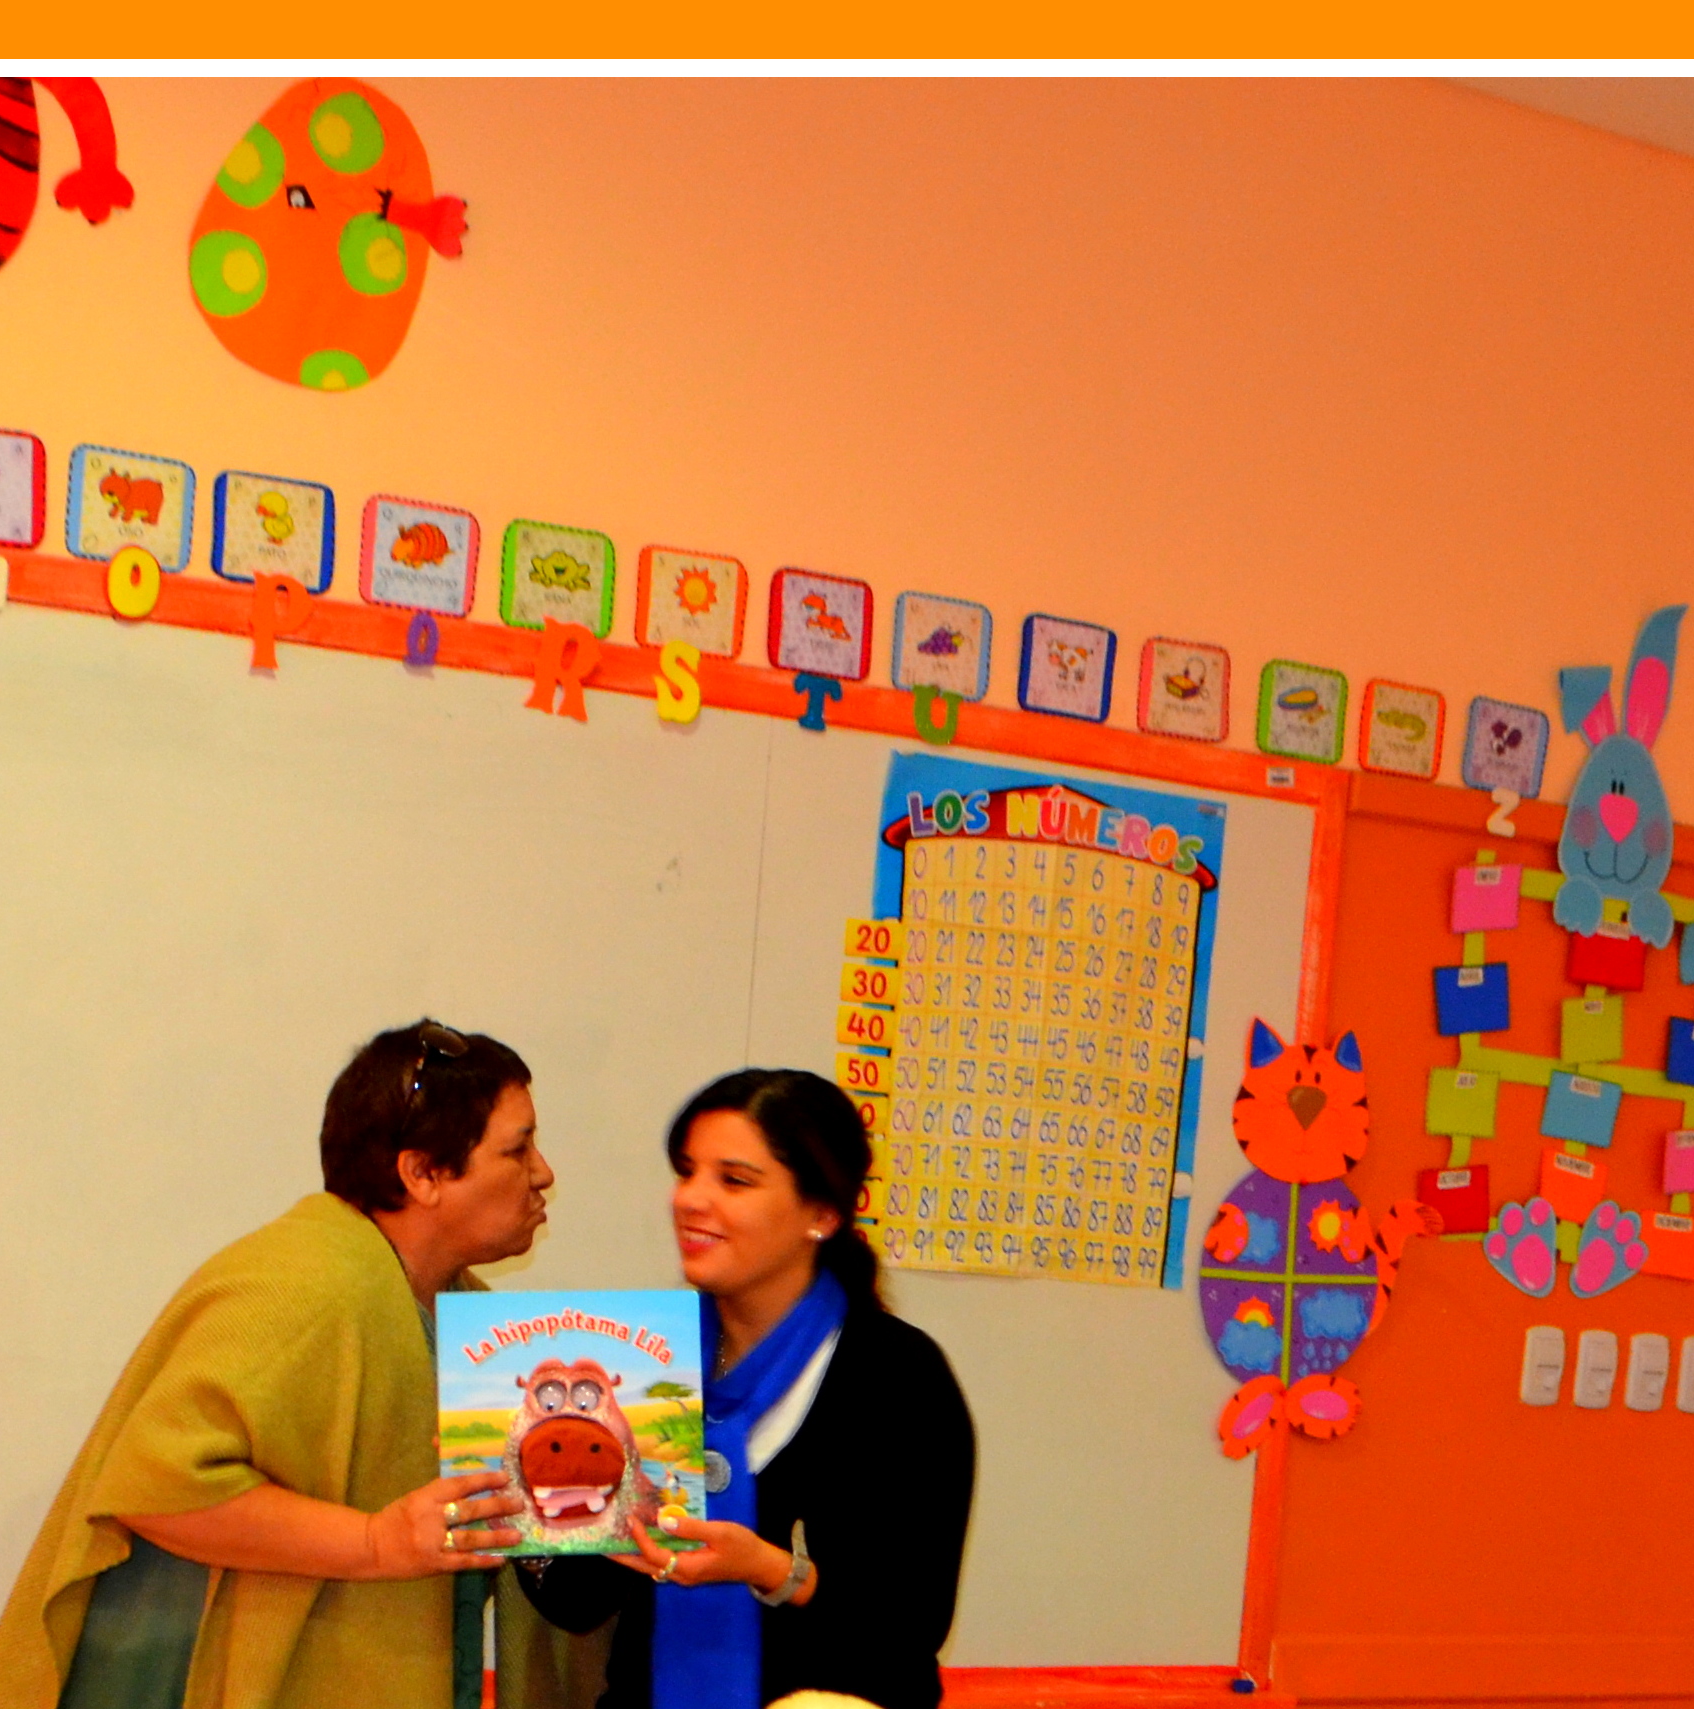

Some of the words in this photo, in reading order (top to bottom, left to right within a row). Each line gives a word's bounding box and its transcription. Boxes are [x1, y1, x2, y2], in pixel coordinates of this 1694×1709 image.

[107, 546, 162, 618] O
[250, 570, 316, 669] P
[524, 615, 601, 722] R
[653, 639, 703, 724] S
[793, 671, 843, 732] T
[912, 684, 963, 745] U
[1487, 789, 1519, 838] Z
[907, 790, 990, 837] LOS
[1006, 785, 1203, 874] NÚMEROS
[913, 847, 927, 879] 0
[944, 846, 954, 877] 1
[975, 846, 986, 879] 2
[1005, 845, 1016, 878] 3
[1034, 851, 1046, 883] 4
[1063, 853, 1077, 885] 5
[1092, 860, 1104, 891] 6
[1123, 864, 1135, 896] 7
[1153, 873, 1163, 906] 8
[1178, 883, 1189, 915] 9
[856, 924, 890, 954] 20
[909, 889, 927, 921] 10
[939, 889, 956, 922] 11
[969, 890, 986, 923] 12
[999, 891, 1014, 924] 13
[1028, 894, 1046, 927] 14
[1057, 897, 1074, 930] 15
[1087, 903, 1105, 935] 16
[1116, 908, 1134, 940] 17
[1146, 916, 1162, 949] 18
[1171, 925, 1188, 955] 19
[852, 969, 887, 998] 30
[907, 930, 927, 963] 20
[936, 930, 955, 964] 21
[966, 932, 985, 966] 22
[996, 932, 1015, 967] 23
[1025, 935, 1045, 968] 24
[1055, 940, 1075, 972] 25
[1085, 944, 1105, 977] 26
[1115, 950, 1133, 983] 27
[1139, 955, 1157, 989] 28
[1166, 963, 1187, 996] 29
[847, 1012, 884, 1042] 40
[904, 971, 925, 1004] 30
[933, 972, 951, 1005] 31
[963, 973, 981, 1008] 32
[993, 975, 1011, 1009] 33
[1021, 978, 1043, 1013] 34
[1050, 982, 1072, 1015] 35
[1081, 987, 1102, 1020] 36
[1109, 991, 1127, 1024] 37
[1134, 996, 1154, 1030] 38
[1162, 1003, 1183, 1037] 39
[847, 1059, 878, 1086] 50
[898, 1016, 921, 1047] 40
[930, 1016, 949, 1048] 41
[960, 1017, 978, 1050] 42
[989, 1020, 1009, 1054] 43
[1017, 1024, 1039, 1056] 44
[1047, 1026, 1069, 1059] 45
[1076, 1030, 1097, 1063] 46
[1105, 1035, 1123, 1067] 47
[1131, 1040, 1150, 1072] 48
[1160, 1047, 1180, 1078] 49
[896, 1056, 919, 1090] 50
[927, 1057, 946, 1090] 51
[957, 1060, 976, 1093] 52
[986, 1062, 1006, 1095] 53
[1013, 1066, 1035, 1098] 54
[1042, 1068, 1066, 1101] 55
[1070, 1072, 1093, 1106] 56
[1098, 1077, 1120, 1107] 57
[1127, 1081, 1147, 1114] 58
[1154, 1086, 1175, 1118] 59
[893, 1100, 916, 1131] 60
[923, 1101, 943, 1133] 61
[952, 1103, 973, 1136] 62
[982, 1105, 1001, 1139] 63
[1011, 1106, 1031, 1139] 64
[1039, 1110, 1061, 1143] 65
[1067, 1114, 1088, 1147] 66
[1095, 1118, 1116, 1149] 67
[1121, 1122, 1142, 1155] 68
[1150, 1126, 1170, 1157] 69
[891, 1143, 913, 1176] 70
[920, 1144, 941, 1176] 71
[952, 1145, 970, 1179] 72
[982, 1147, 1000, 1181] 73
[1009, 1150, 1027, 1182] 74
[1037, 1154, 1059, 1186] 75
[1066, 1156, 1085, 1188] 76
[1092, 1160, 1112, 1191] 77
[1119, 1162, 1137, 1194] 78
[1148, 1167, 1166, 1198] 79
[887, 1183, 910, 1216] 80
[918, 1186, 938, 1219] 81
[949, 1188, 969, 1221] 82
[978, 1189, 998, 1222] 83
[1005, 1191, 1025, 1223] 84
[1034, 1194, 1056, 1226] 85
[1062, 1196, 1081, 1229] 86
[1087, 1200, 1108, 1231] 87
[1113, 1203, 1133, 1235] 88
[1142, 1206, 1162, 1237] 89
[884, 1227, 906, 1260] 90
[914, 1229, 934, 1261] 91
[945, 1230, 965, 1263] 92
[975, 1231, 993, 1264] 93
[1002, 1234, 1022, 1264] 94
[1031, 1236, 1052, 1268] 95
[1057, 1238, 1077, 1269] 96
[1085, 1242, 1104, 1272] 97
[1112, 1244, 1130, 1277] 98
[1138, 1247, 1157, 1278] 99
[462, 1340, 495, 1365] La
[491, 1308, 631, 1345] hipopótama
[634, 1328, 673, 1365] Lila
